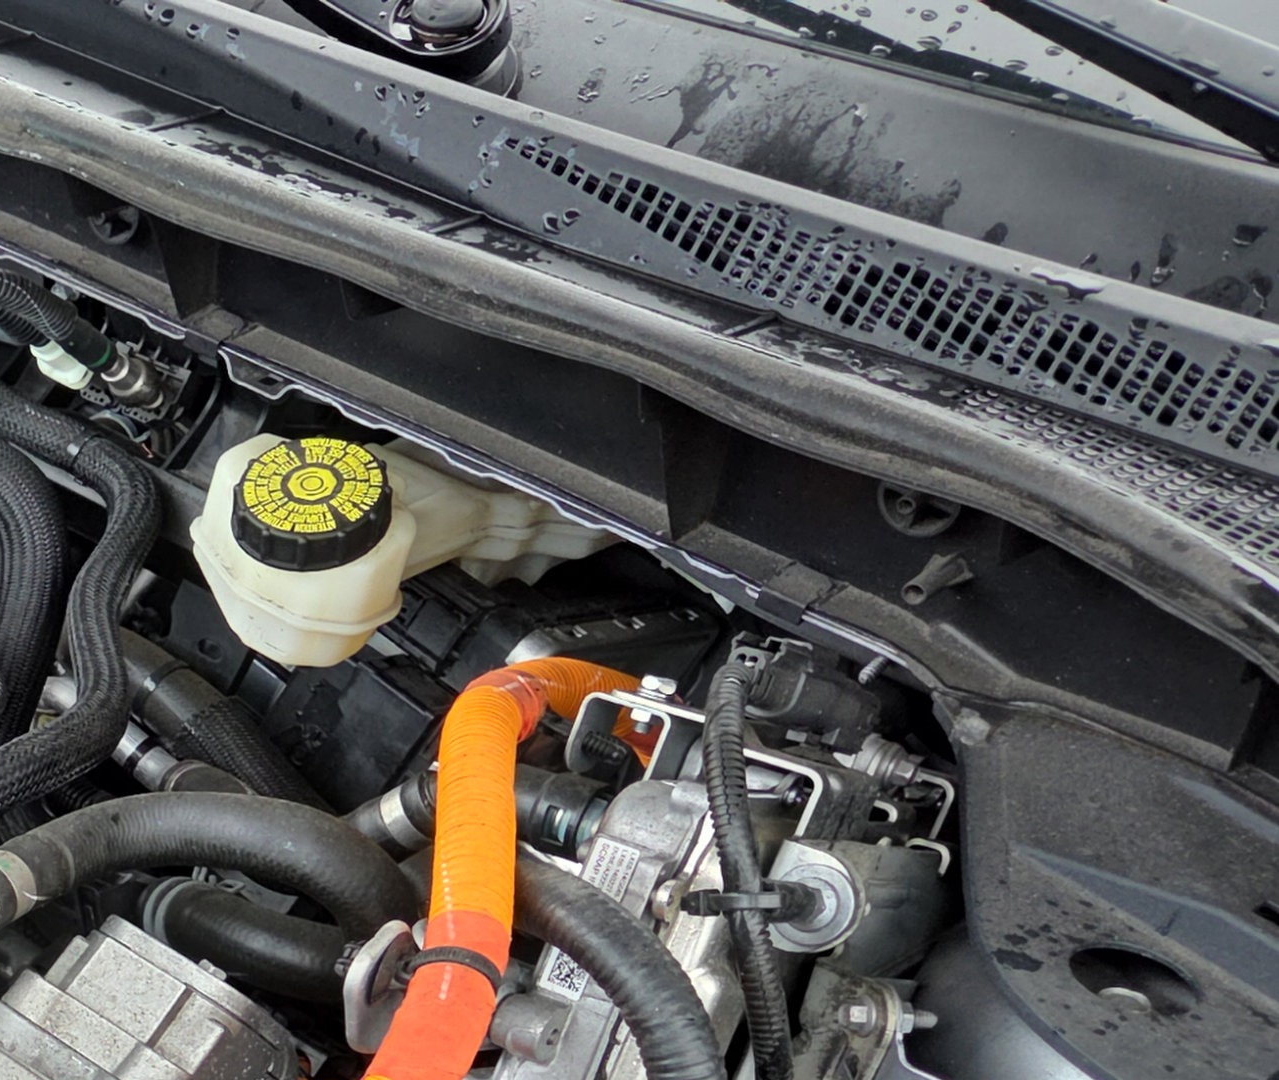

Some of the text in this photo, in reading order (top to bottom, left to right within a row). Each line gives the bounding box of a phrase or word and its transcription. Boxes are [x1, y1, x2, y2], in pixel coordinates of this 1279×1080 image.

[299, 437, 348, 450] CONTAINER
[292, 520, 338, 533] ATTENTION
[593, 843, 610, 878] SCRAP
